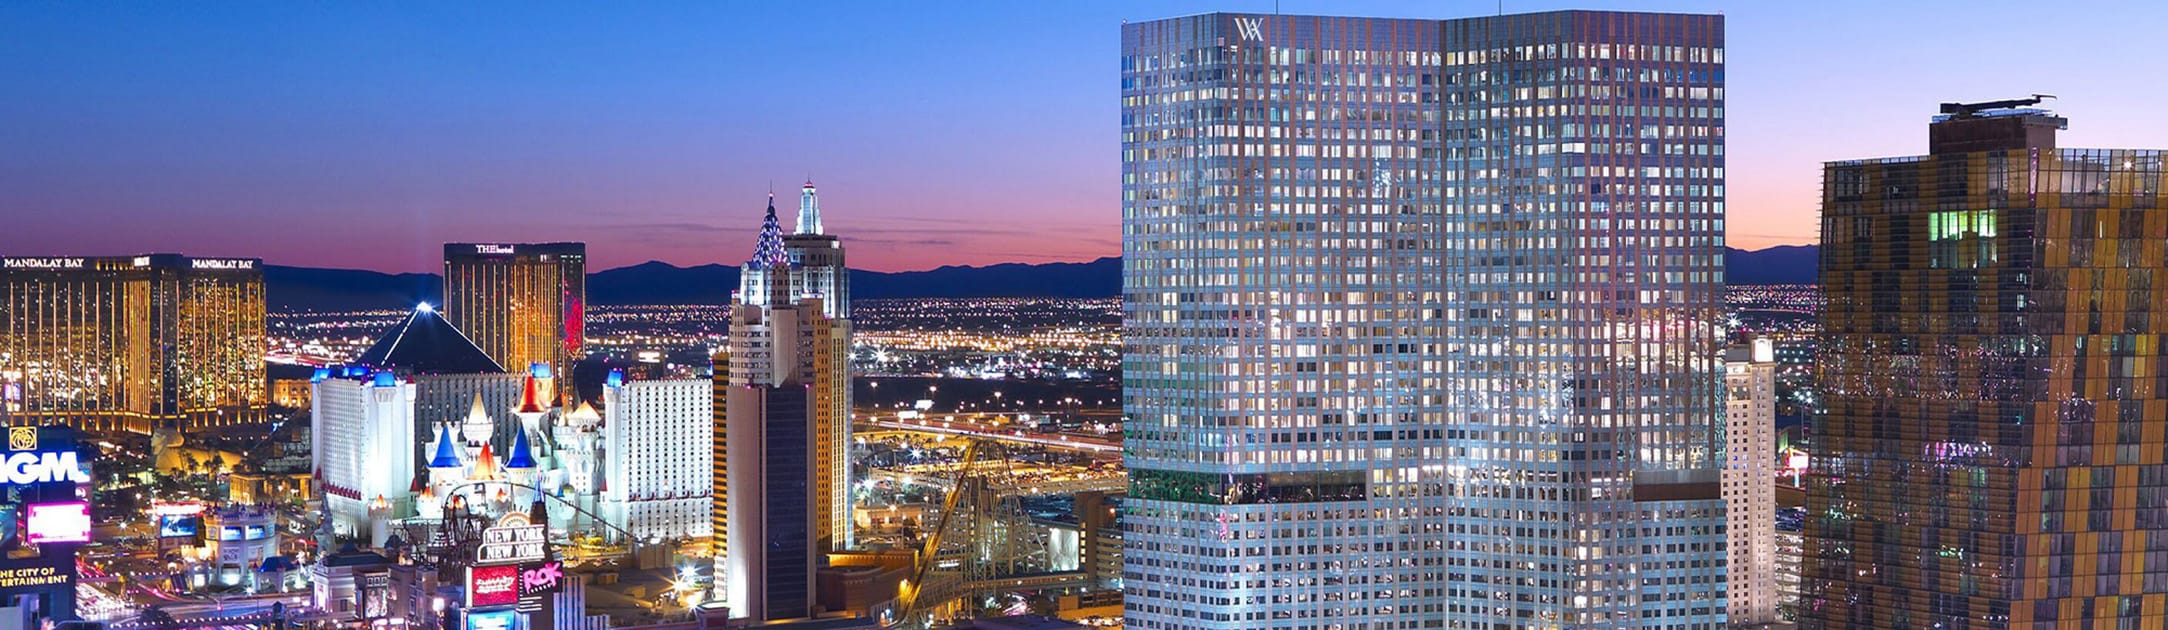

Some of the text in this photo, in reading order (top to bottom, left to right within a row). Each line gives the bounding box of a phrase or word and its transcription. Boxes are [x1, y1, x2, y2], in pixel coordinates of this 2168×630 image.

[4, 258, 84, 268] MANDALAY BAY
[192, 258, 254, 269] MANDALAY BAY
[487, 527, 545, 543] NEW YORK
[486, 543, 545, 559] NEW YORK
[0, 567, 55, 578] HE CITY OF
